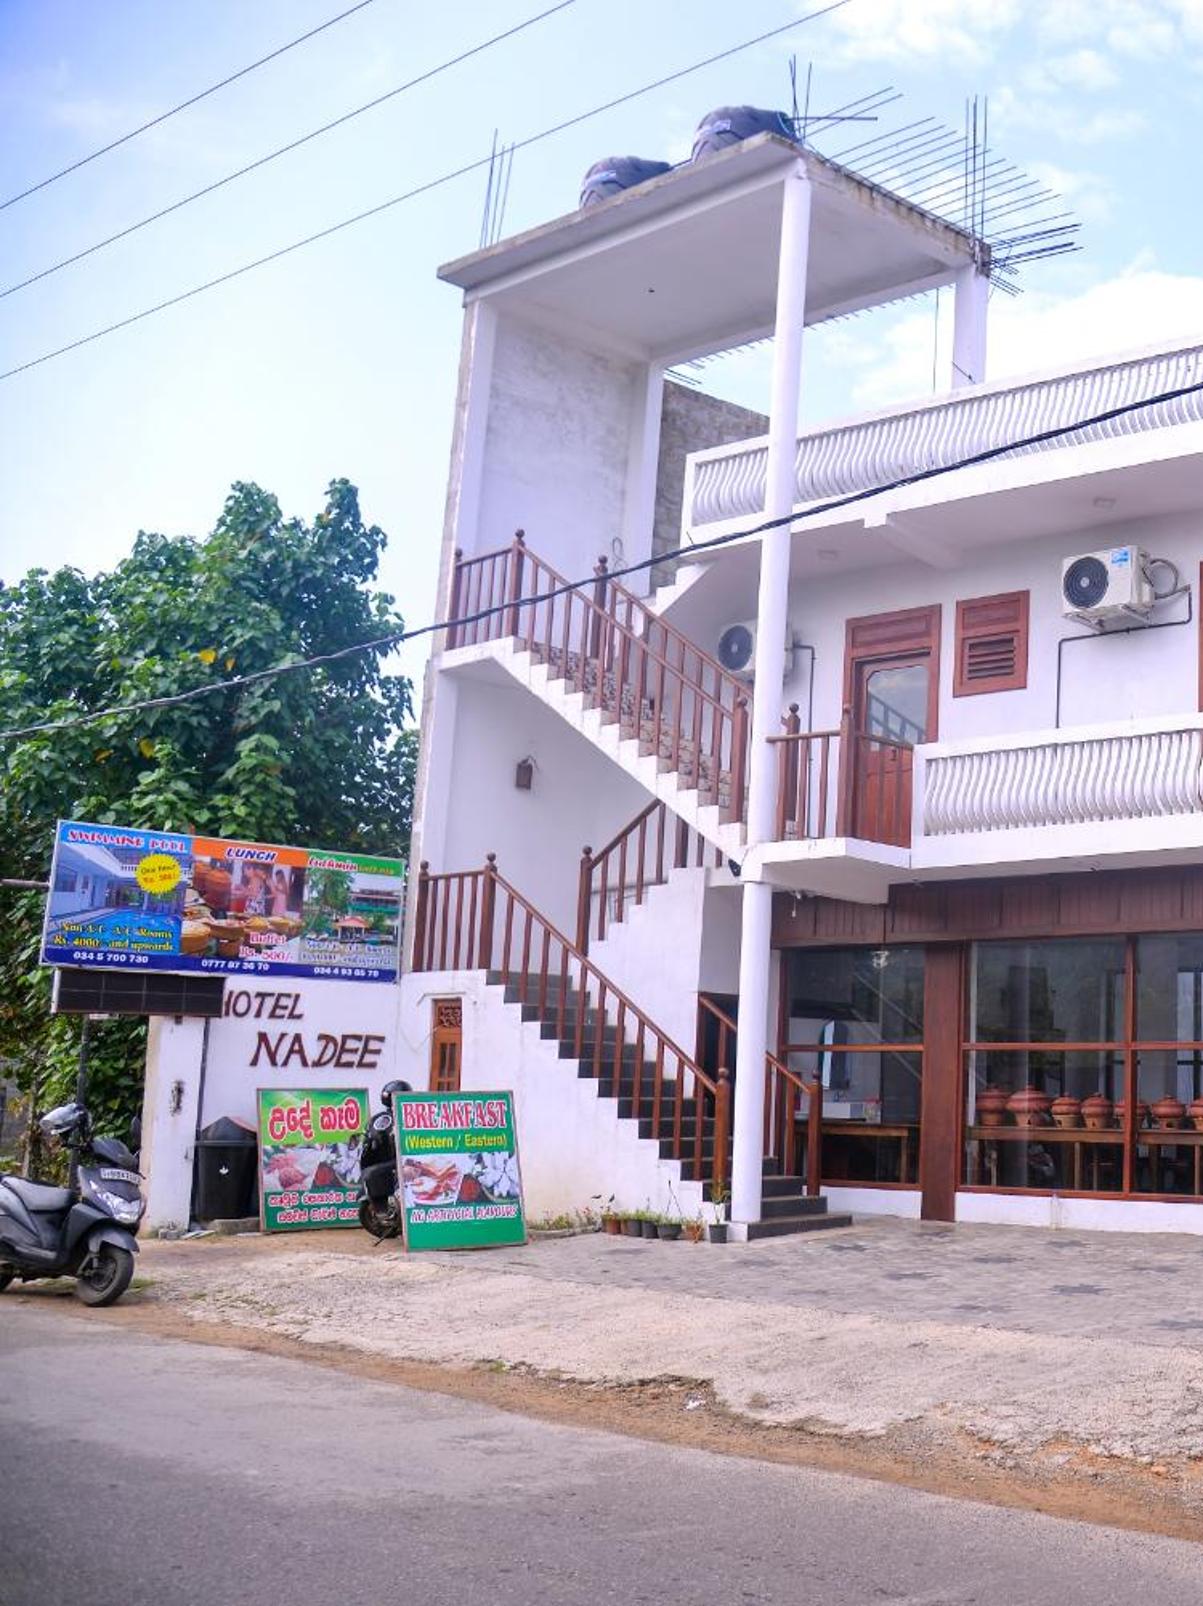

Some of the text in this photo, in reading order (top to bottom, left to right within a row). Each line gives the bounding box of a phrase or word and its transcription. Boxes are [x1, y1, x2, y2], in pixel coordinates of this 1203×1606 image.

[149, 838, 189, 854] POOL
[226, 847, 277, 861] LUNCH
[138, 927, 173, 939] Rooms
[109, 939, 130, 949] and
[131, 942, 173, 953] upwards
[73, 950, 149, 963] 034 5 700 730
[201, 959, 228, 969] 0777
[250, 1031, 386, 1069] NADEE
[268, 1099, 314, 1142] උදේ
[402, 1101, 507, 1130] BREAKFAST
[405, 1134, 453, 1152] (Western
[464, 1132, 507, 1147] Eastern)
